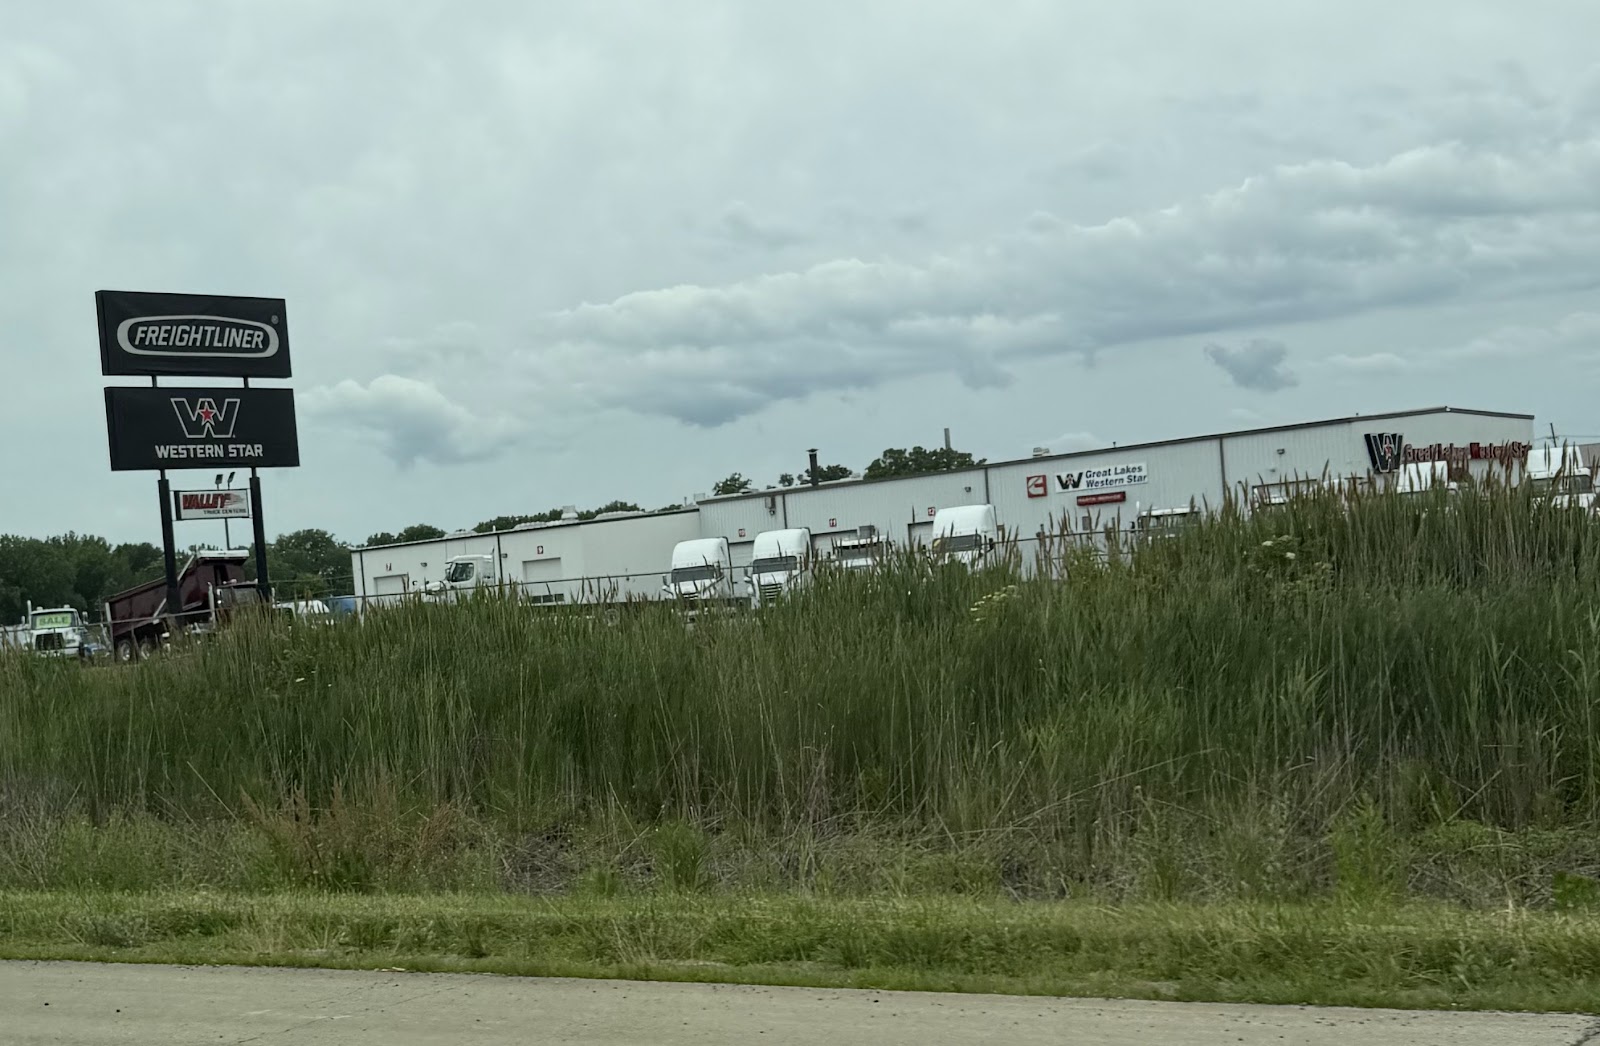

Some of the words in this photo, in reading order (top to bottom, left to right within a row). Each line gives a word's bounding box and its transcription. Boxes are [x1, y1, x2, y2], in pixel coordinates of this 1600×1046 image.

[134, 325, 264, 349] FREIGHTLINER
[154, 444, 225, 459] WESTERN
[228, 444, 264, 457] STAR
[1085, 468, 1111, 479] Great
[1114, 465, 1143, 476] Lakes
[1086, 477, 1124, 488] Western
[1126, 475, 1147, 484] Star
[182, 493, 231, 510] VALLEY
[39, 616, 70, 626] SALE
